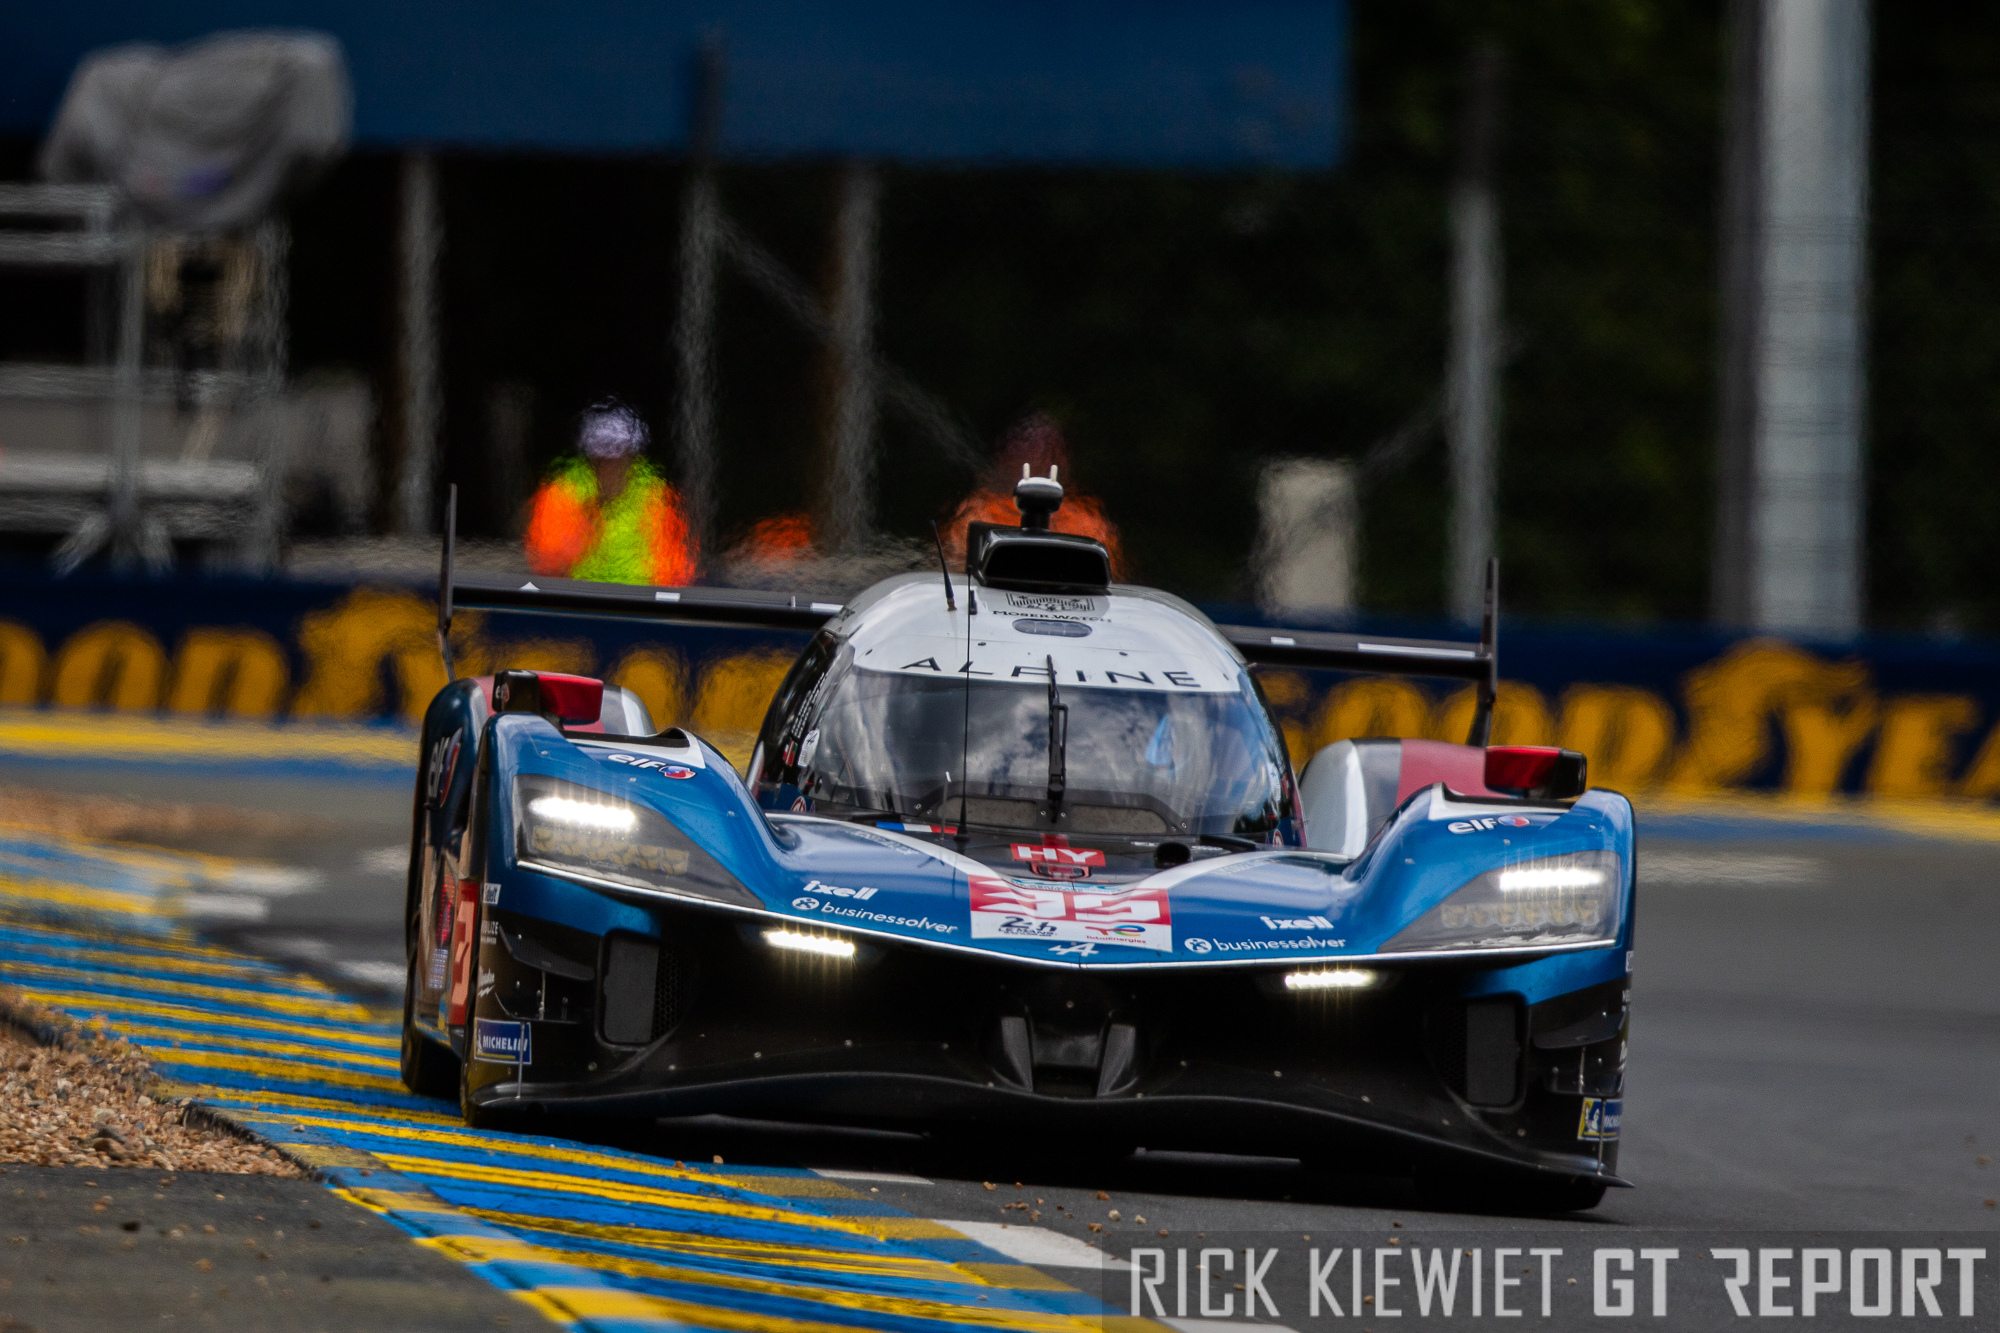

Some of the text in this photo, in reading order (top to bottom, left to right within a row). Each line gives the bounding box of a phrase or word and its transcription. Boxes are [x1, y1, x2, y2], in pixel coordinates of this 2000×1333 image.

[900, 656, 1202, 688] ALPINE
[607, 753, 667, 769] elf
[1447, 817, 1498, 834] elf
[1017, 845, 1099, 863] HY
[803, 880, 879, 900] ixell
[821, 902, 958, 934] businessolver
[1260, 916, 1334, 930] ixell
[1213, 936, 1346, 951] businessolver
[483, 1035, 529, 1052] MICHELIN
